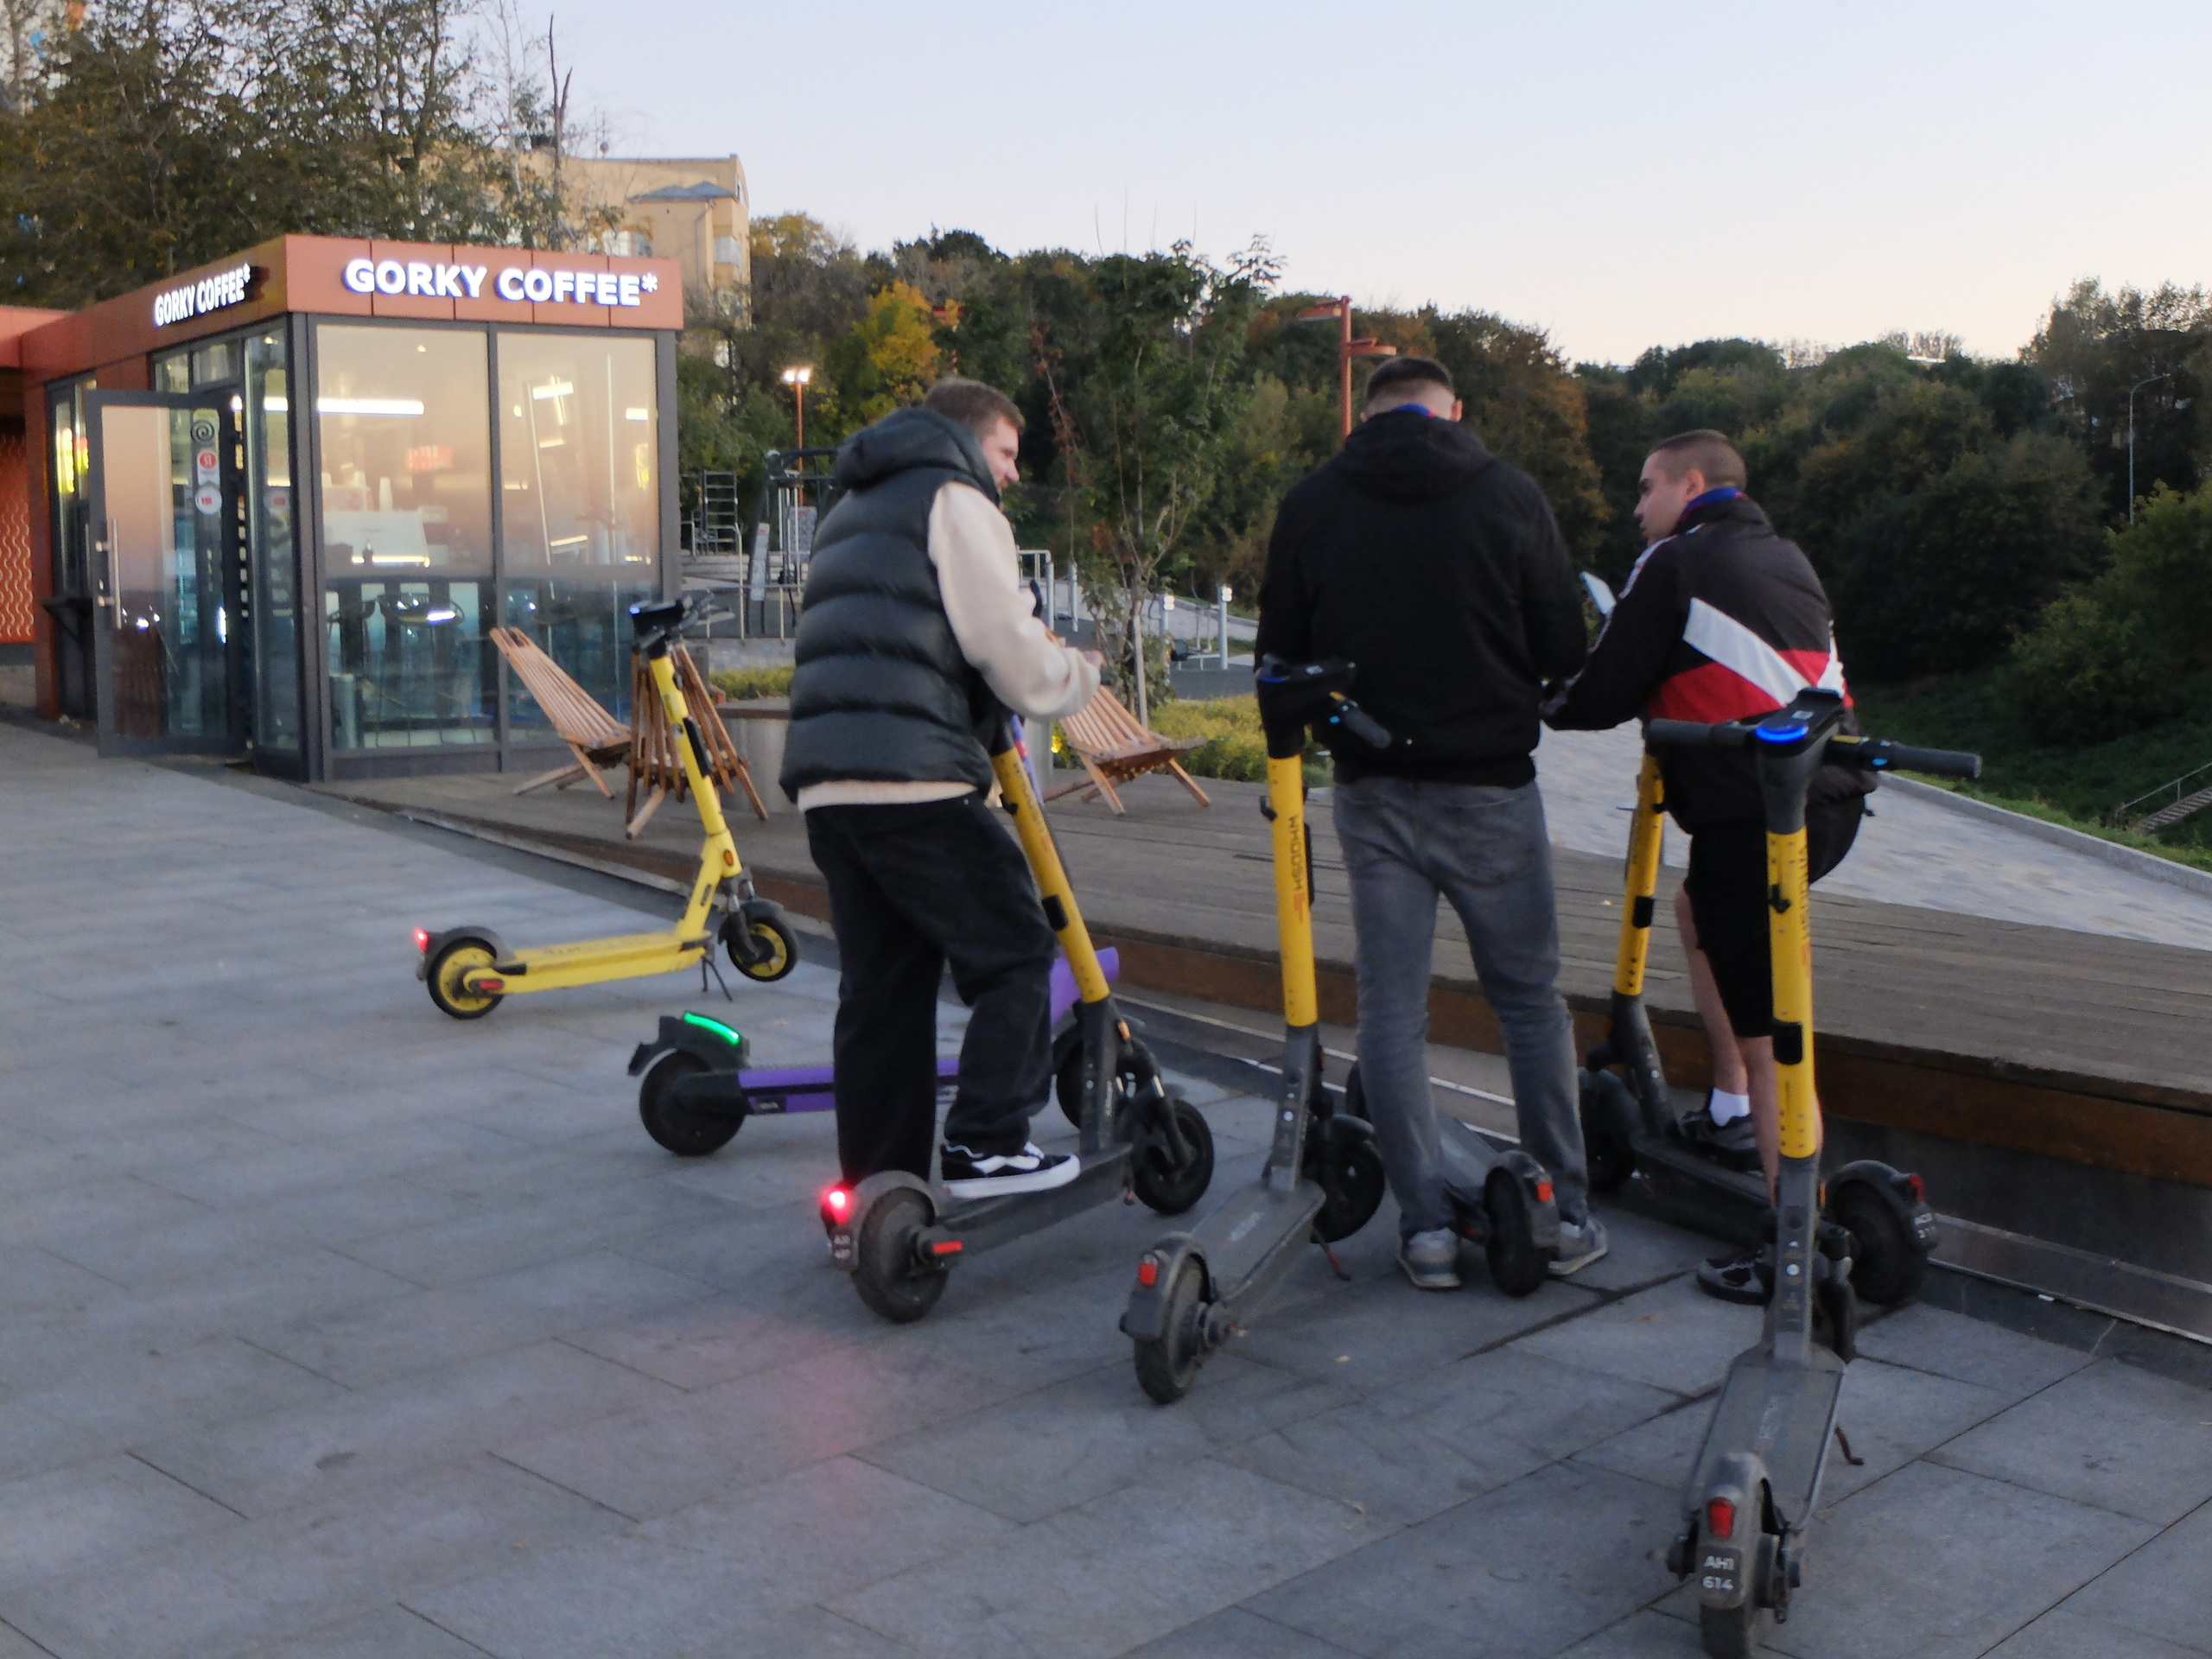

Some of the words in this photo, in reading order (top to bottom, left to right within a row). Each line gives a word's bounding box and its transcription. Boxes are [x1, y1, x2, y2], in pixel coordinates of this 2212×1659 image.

[346, 258, 486, 298] GORKY
[155, 284, 196, 327] GORKY
[1702, 1575, 1734, 1591] 614
